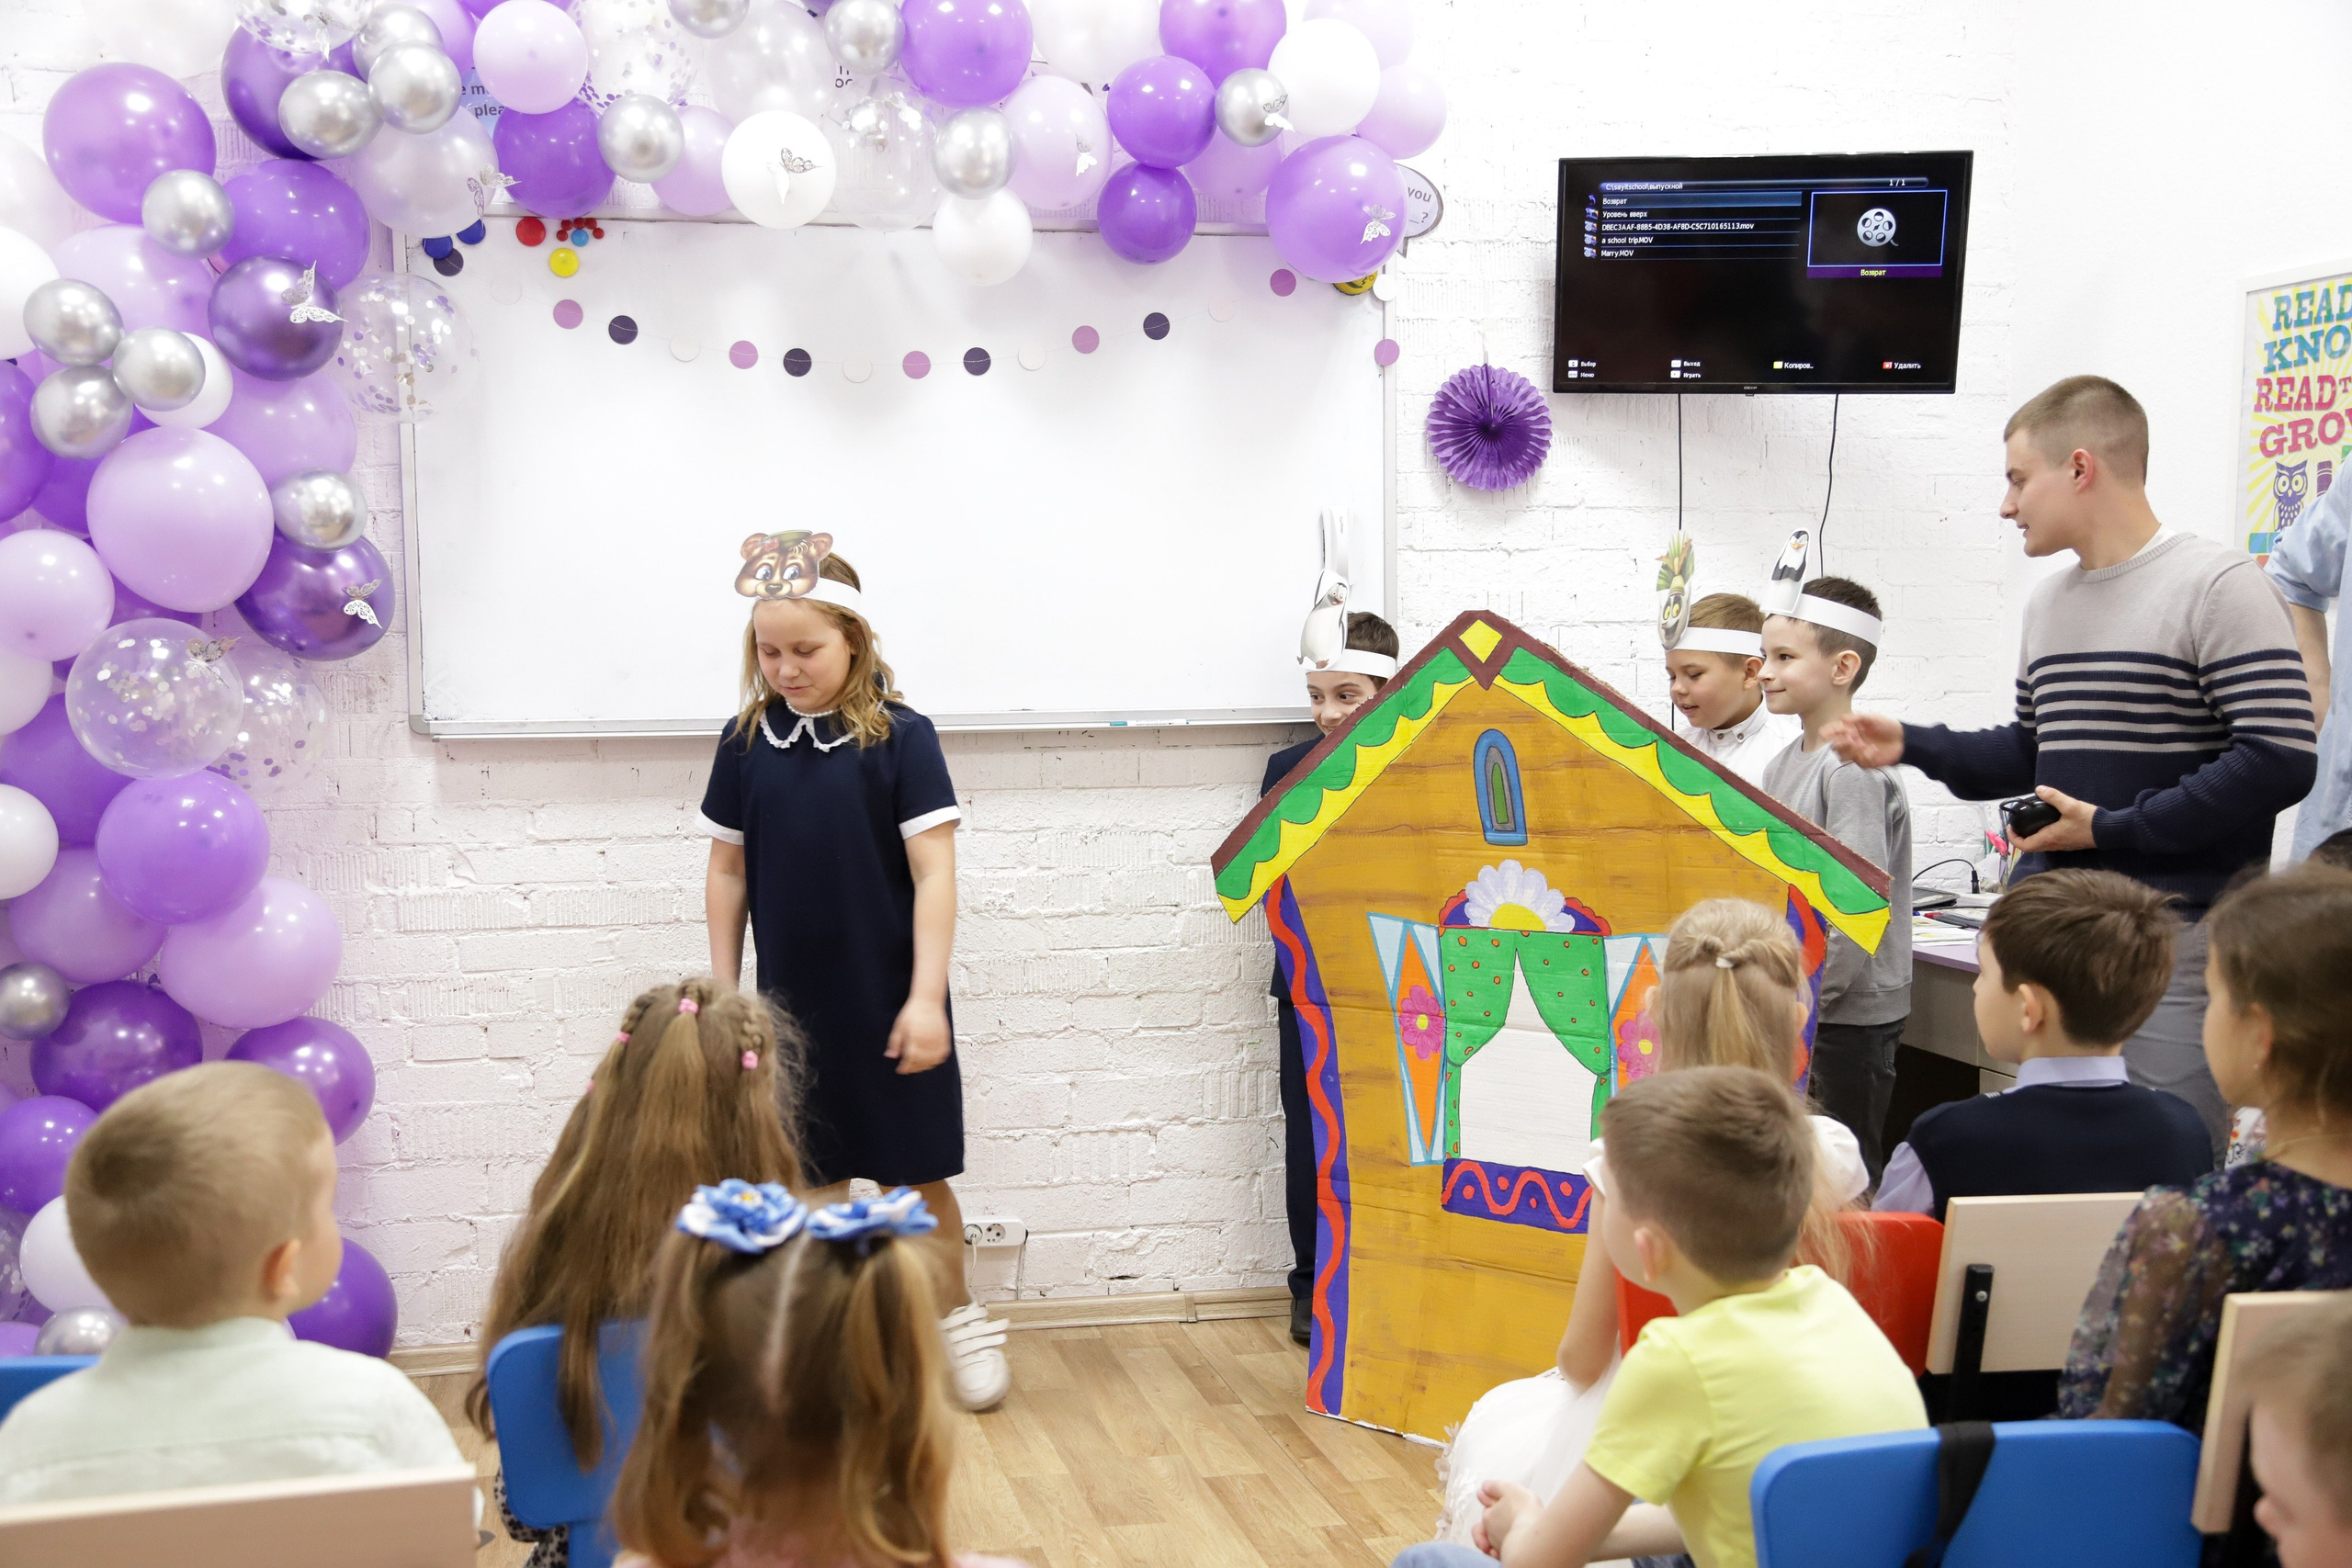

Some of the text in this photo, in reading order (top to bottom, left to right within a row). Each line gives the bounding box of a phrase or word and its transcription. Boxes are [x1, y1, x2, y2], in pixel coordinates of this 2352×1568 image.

[1602, 197, 1627, 206] Возврат
[1600, 249, 1634, 258] Marry.MOV
[1628, 236, 1654, 244] trip.MOV
[2272, 283, 2352, 332] READ
[2263, 323, 2352, 375] KNO
[2254, 374, 2337, 412] READ
[2259, 407, 2352, 458] GRO
